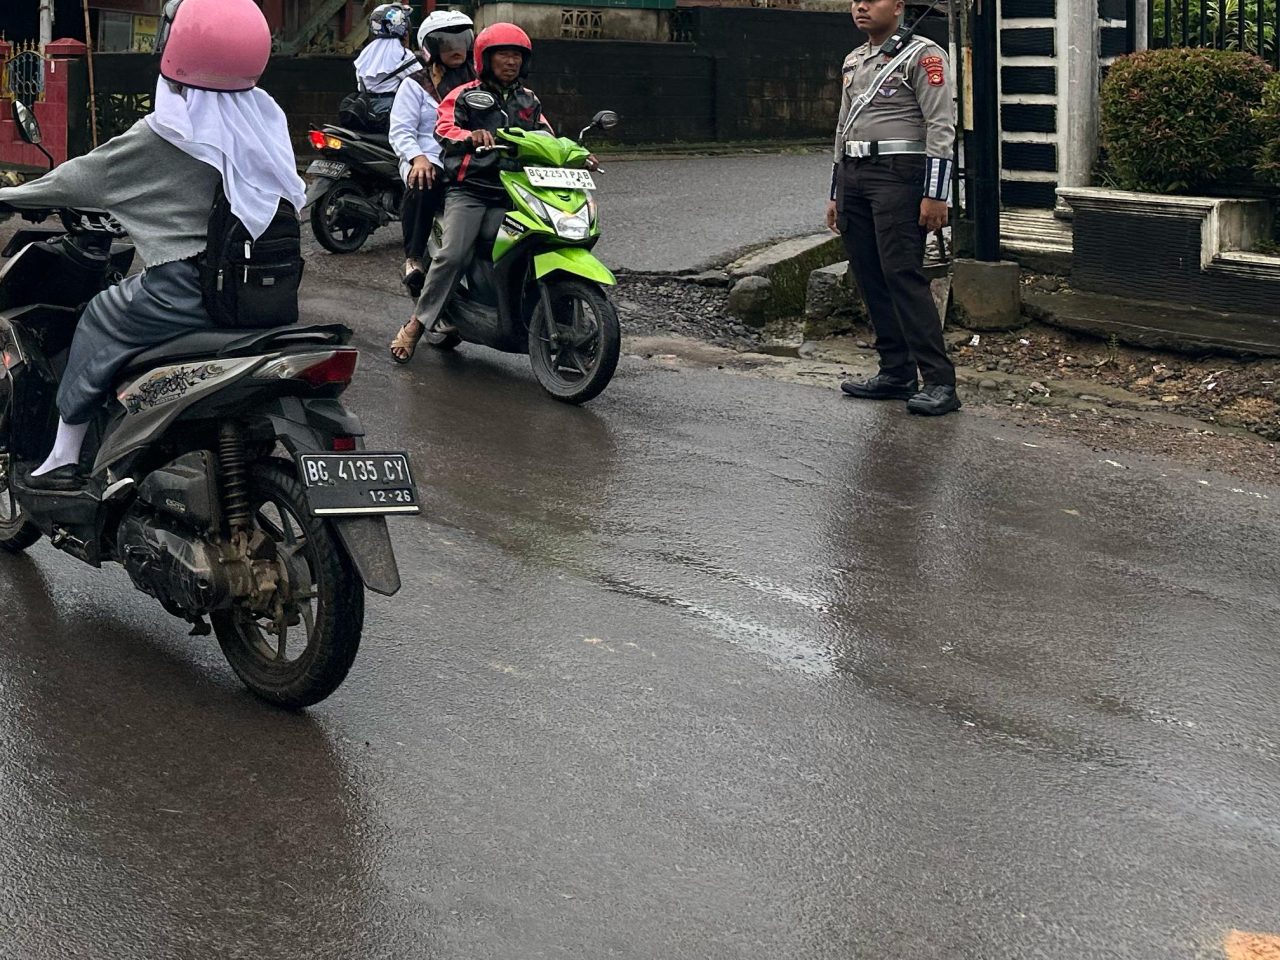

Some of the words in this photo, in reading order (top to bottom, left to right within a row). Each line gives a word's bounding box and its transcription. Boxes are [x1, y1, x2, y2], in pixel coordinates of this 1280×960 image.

[528, 168, 542, 177] BG
[306, 460, 329, 482] BG
[338, 460, 378, 481] 4135
[383, 460, 404, 481] CY
